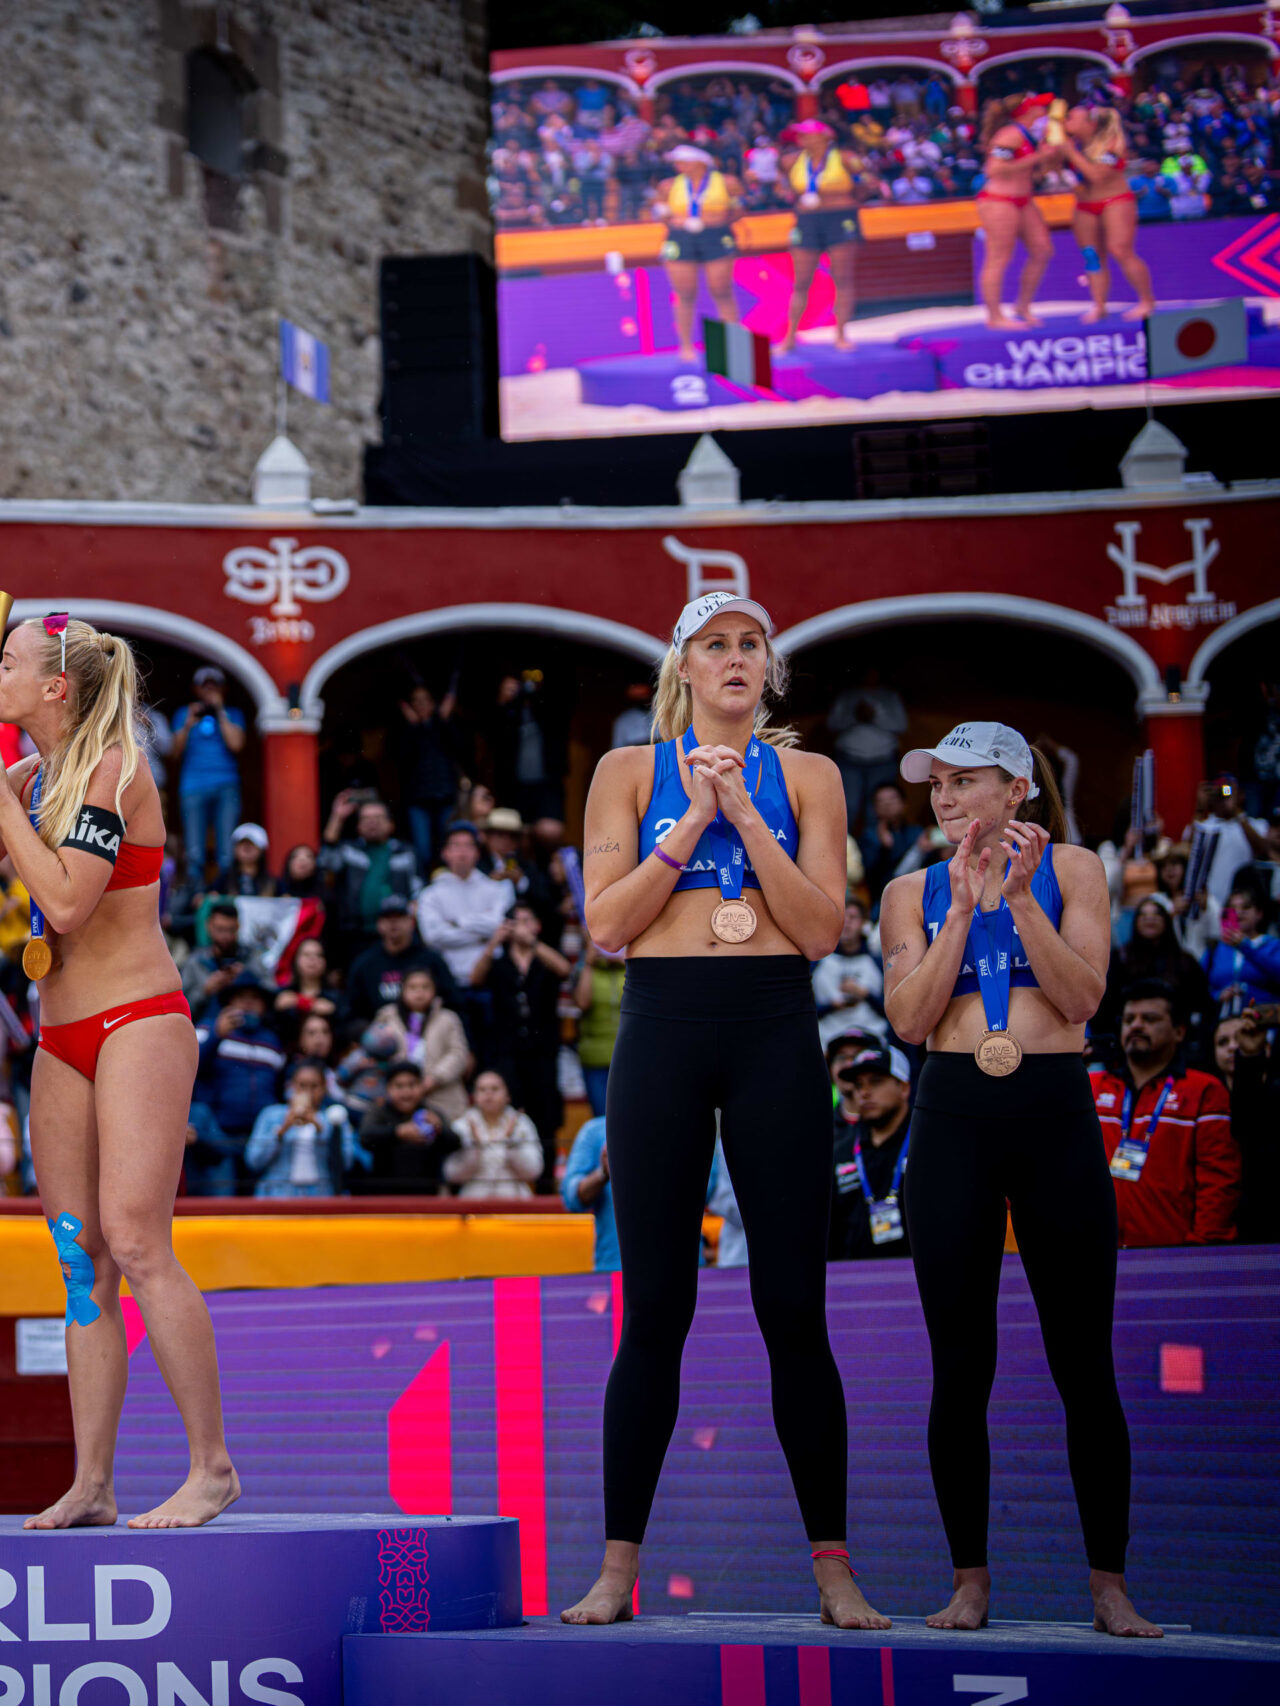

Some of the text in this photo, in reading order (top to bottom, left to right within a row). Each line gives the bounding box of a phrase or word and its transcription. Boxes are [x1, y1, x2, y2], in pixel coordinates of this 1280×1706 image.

[963, 352, 1147, 387] CHAMPIO
[69, 823, 120, 856] IKA
[654, 818, 677, 843] 2
[734, 847, 743, 865] FIVB
[720, 867, 729, 885] FIVB
[721, 912, 749, 922] FIVB
[979, 959, 988, 976] FIVB
[984, 1045, 1013, 1056] FIVB
